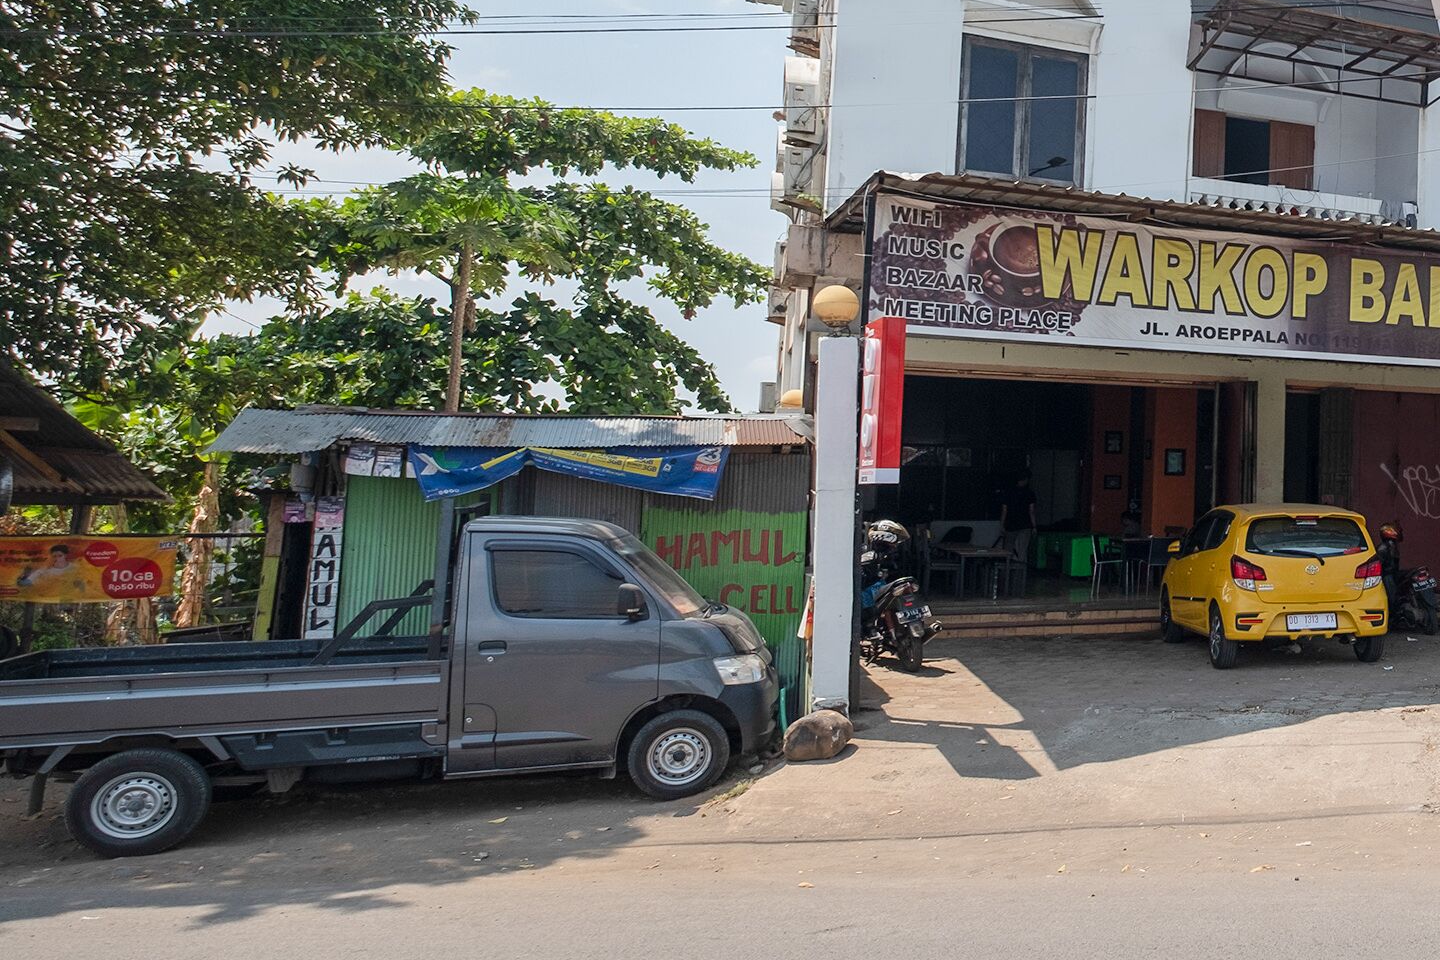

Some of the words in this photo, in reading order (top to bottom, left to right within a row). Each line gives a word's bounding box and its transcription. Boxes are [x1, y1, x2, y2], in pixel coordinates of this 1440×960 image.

[890, 205, 942, 227] WIFI
[888, 236, 965, 260] MUSIC
[886, 267, 984, 292] BAZAAR
[1034, 223, 1330, 320] WARKOP
[884, 299, 993, 325] MEETING
[998, 308, 1073, 330] PLACE
[1140, 322, 1169, 336] JL.
[1176, 325, 1289, 344] AROEPPALA
[656, 529, 796, 570] HAMUL
[108, 582, 134, 592] Rp50
[135, 582, 155, 590] ribu
[309, 526, 337, 631] AMUL
[720, 583, 799, 615] CELL
[1304, 616, 1319, 624] 1313
[1325, 615, 1335, 623] XX
